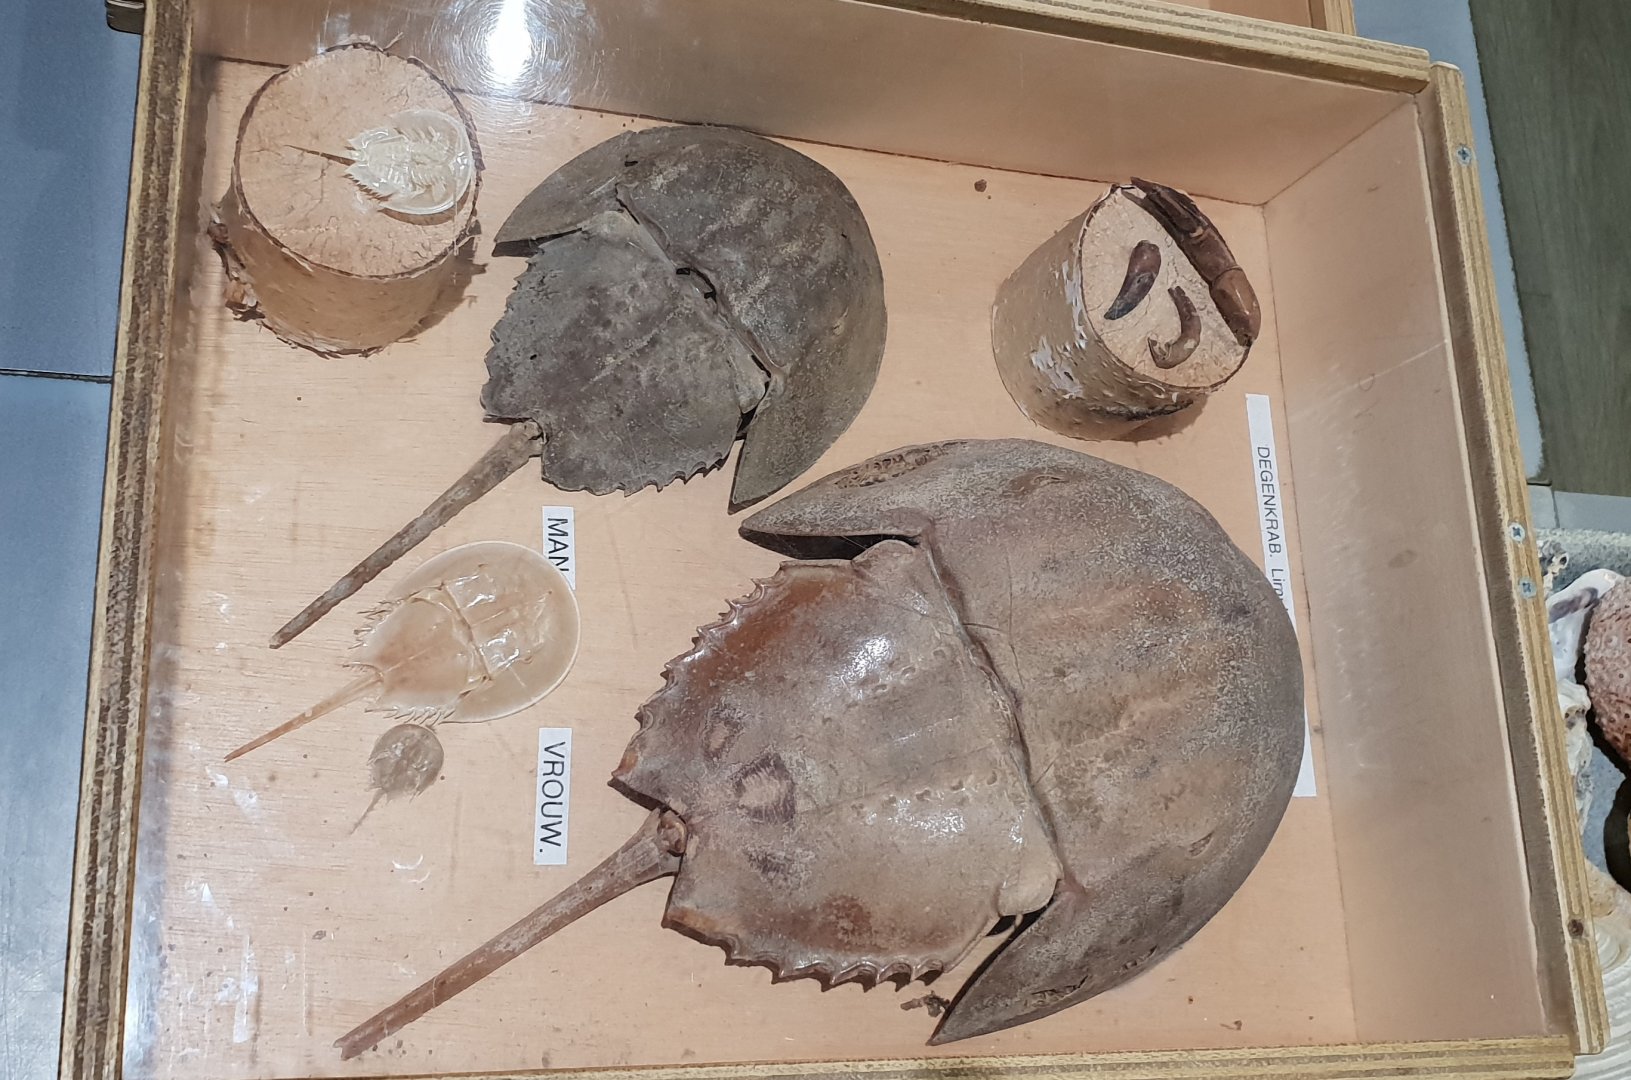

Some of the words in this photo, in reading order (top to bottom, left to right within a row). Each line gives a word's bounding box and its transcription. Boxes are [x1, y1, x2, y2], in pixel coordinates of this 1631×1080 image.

[547, 517, 570, 572] MAN
[1257, 446, 1282, 557] DEGENKRAB.
[1271, 568, 1286, 601] Lim
[539, 741, 566, 853] VROUW.
